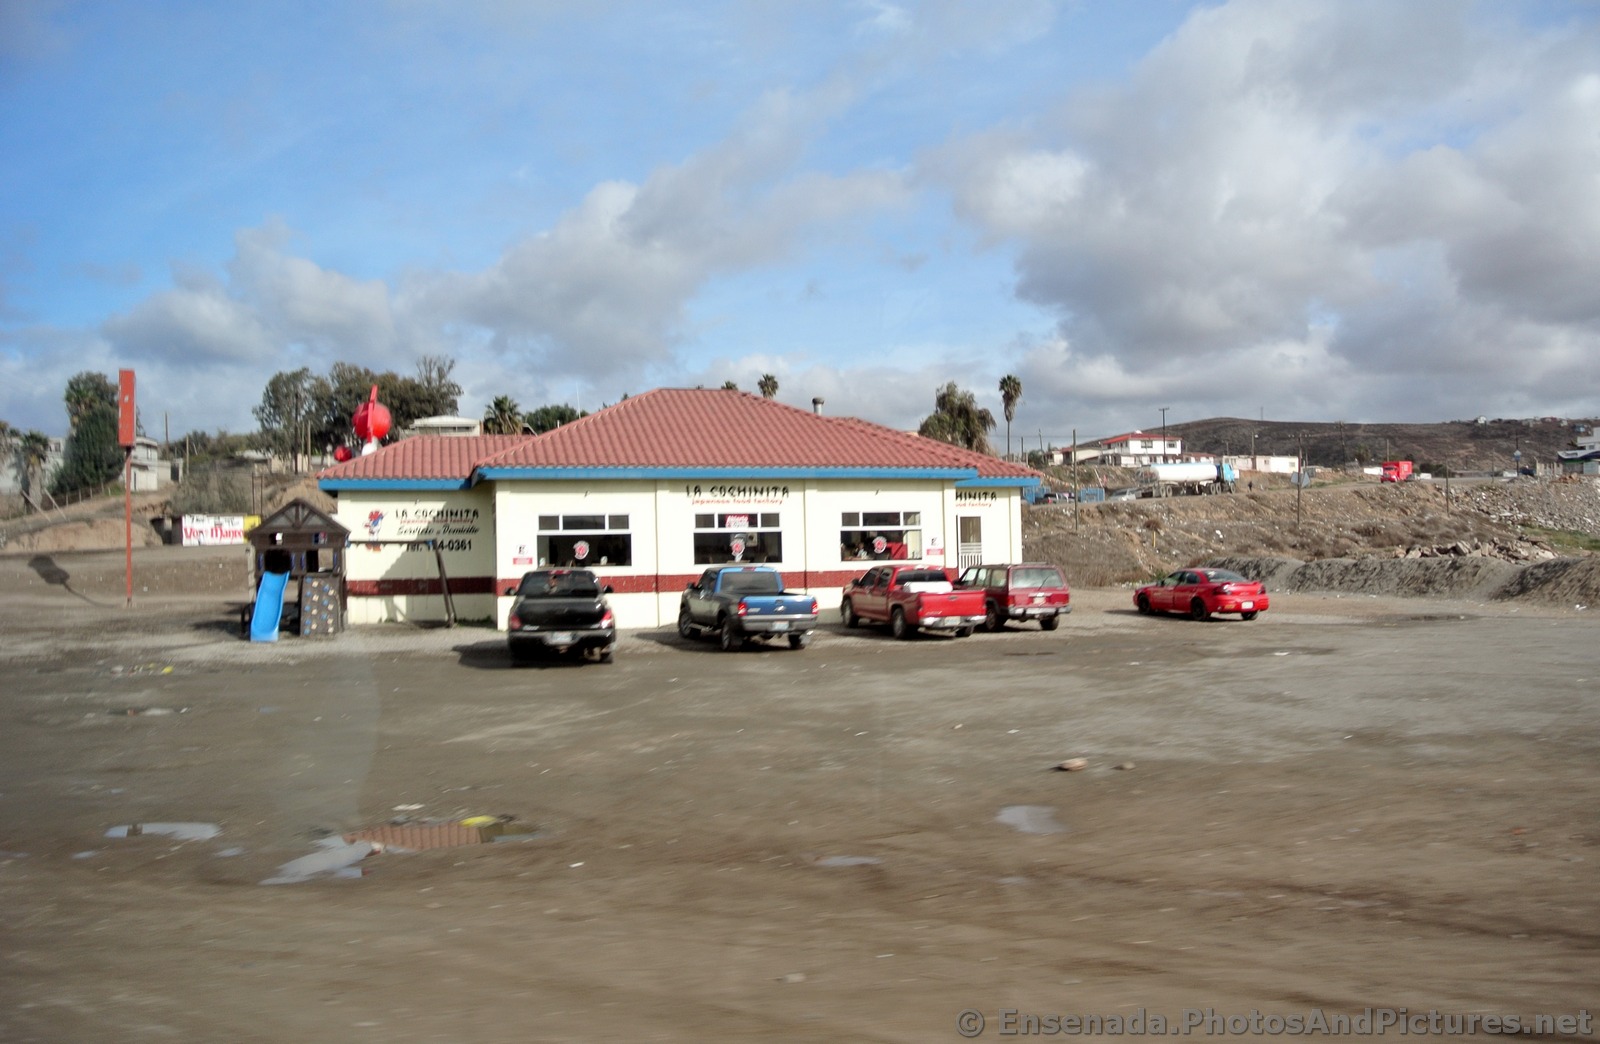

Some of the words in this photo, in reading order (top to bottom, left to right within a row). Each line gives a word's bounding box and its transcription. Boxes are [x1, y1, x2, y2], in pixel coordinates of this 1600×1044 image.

[686, 485, 702, 498] LA
[710, 485, 789, 498] COCHINITA
[395, 509, 408, 519] LA
[415, 509, 479, 519] COCHINITA
